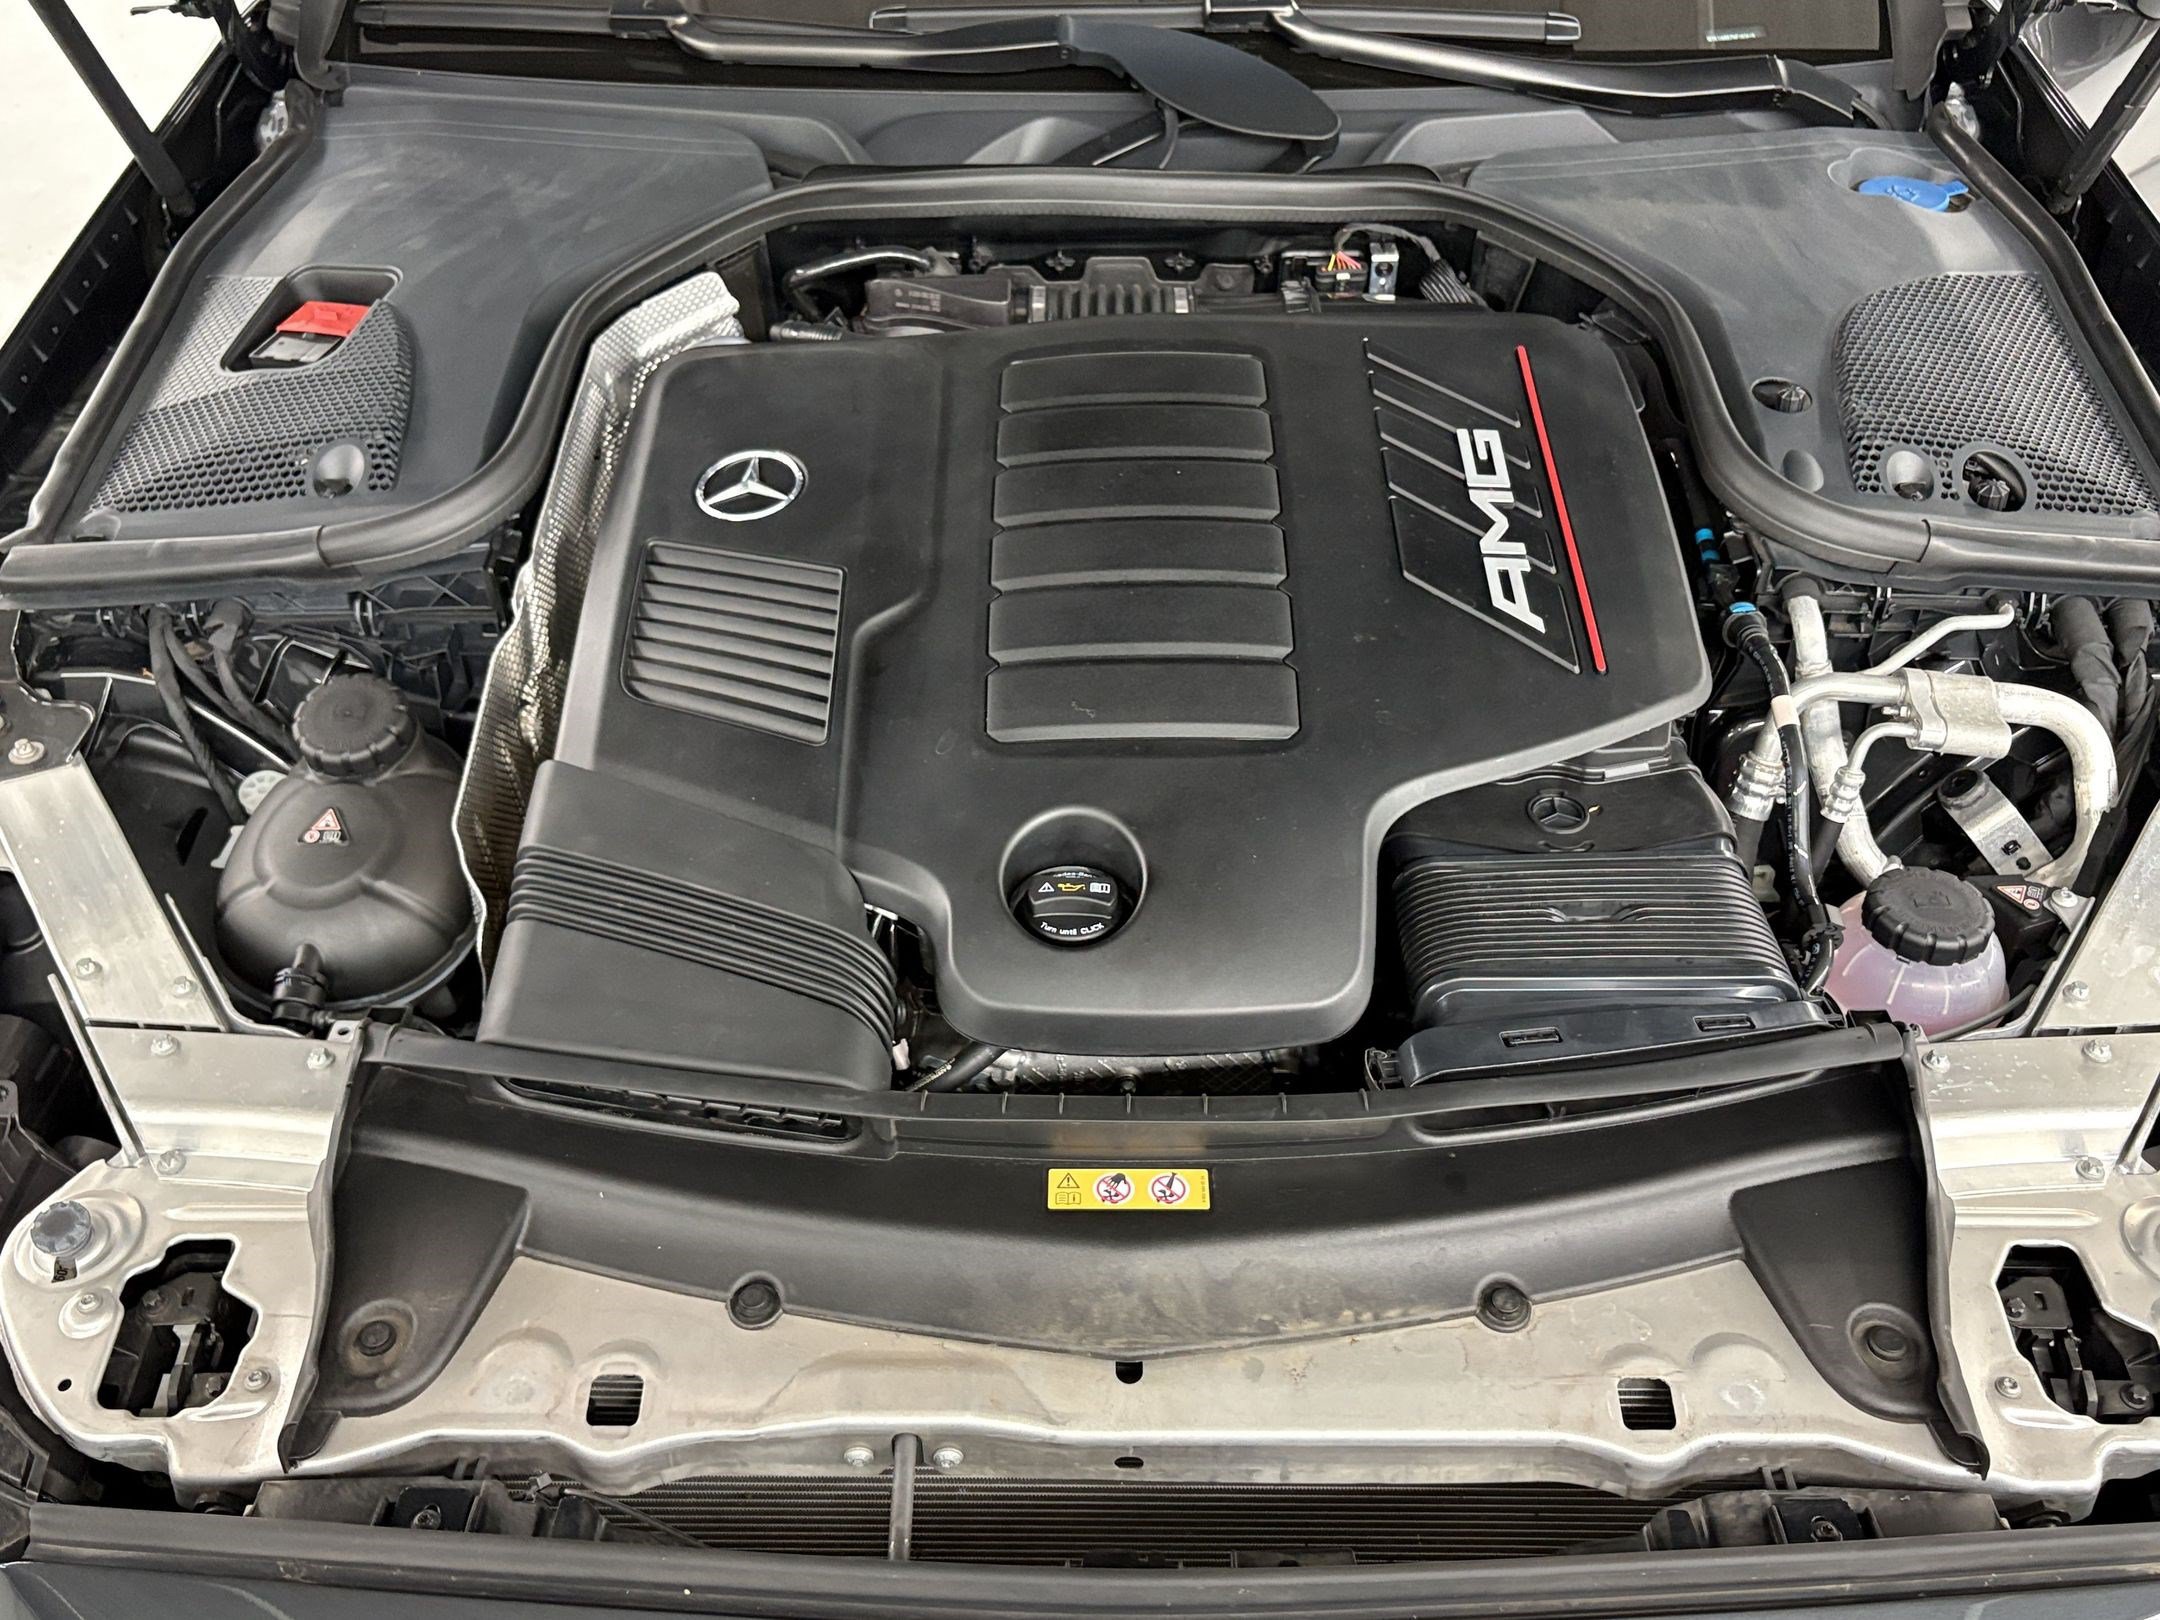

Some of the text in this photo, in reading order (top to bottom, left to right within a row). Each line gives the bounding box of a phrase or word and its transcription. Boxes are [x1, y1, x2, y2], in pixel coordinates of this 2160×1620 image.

[1456, 428, 1546, 634] AMG
[1040, 921, 1057, 933] Turn
[1080, 922, 1105, 934] CLICK
